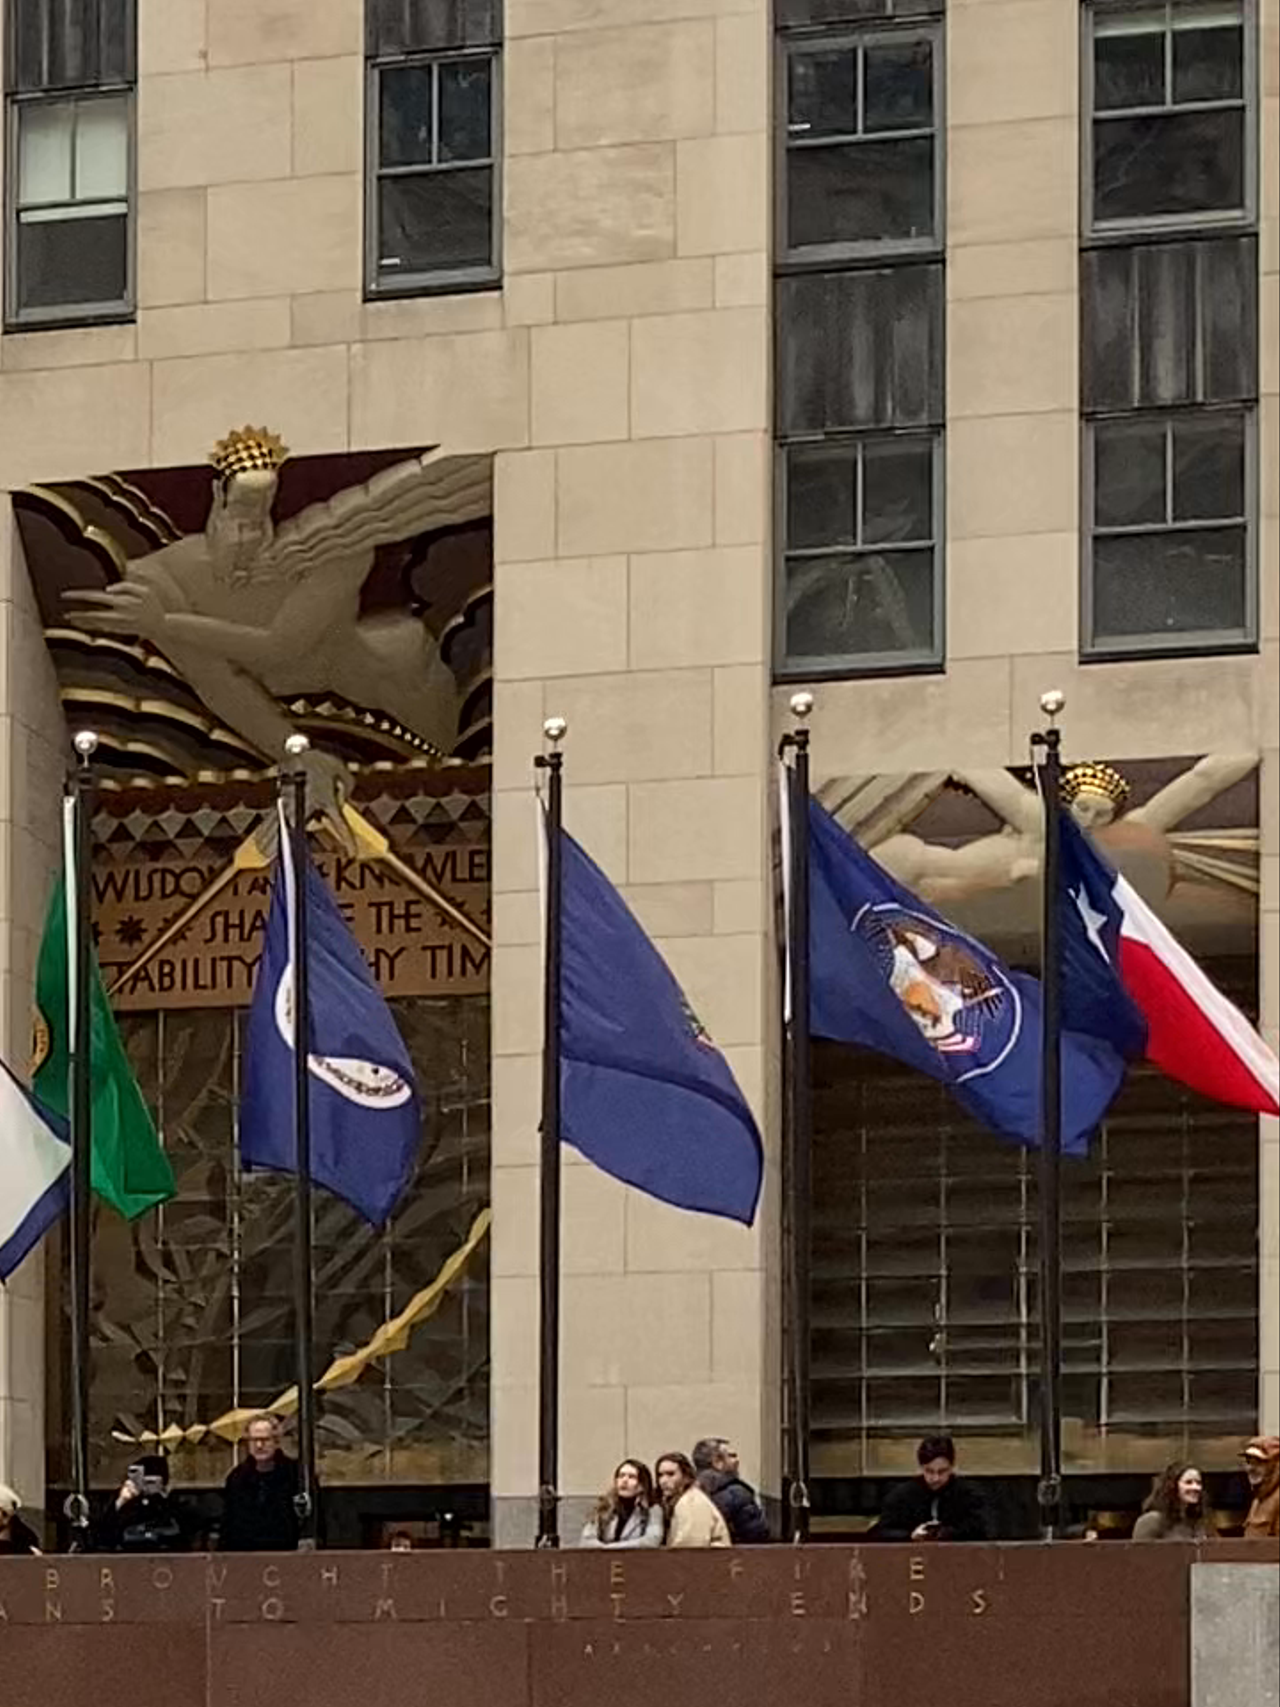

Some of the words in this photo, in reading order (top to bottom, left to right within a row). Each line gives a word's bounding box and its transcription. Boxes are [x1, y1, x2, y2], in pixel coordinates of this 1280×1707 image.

[91, 864, 239, 904] WISDO
[203, 909, 268, 942] SHA
[367, 899, 423, 934] THE
[99, 954, 262, 994] TABILITY
[494, 1560, 626, 1586] THE
